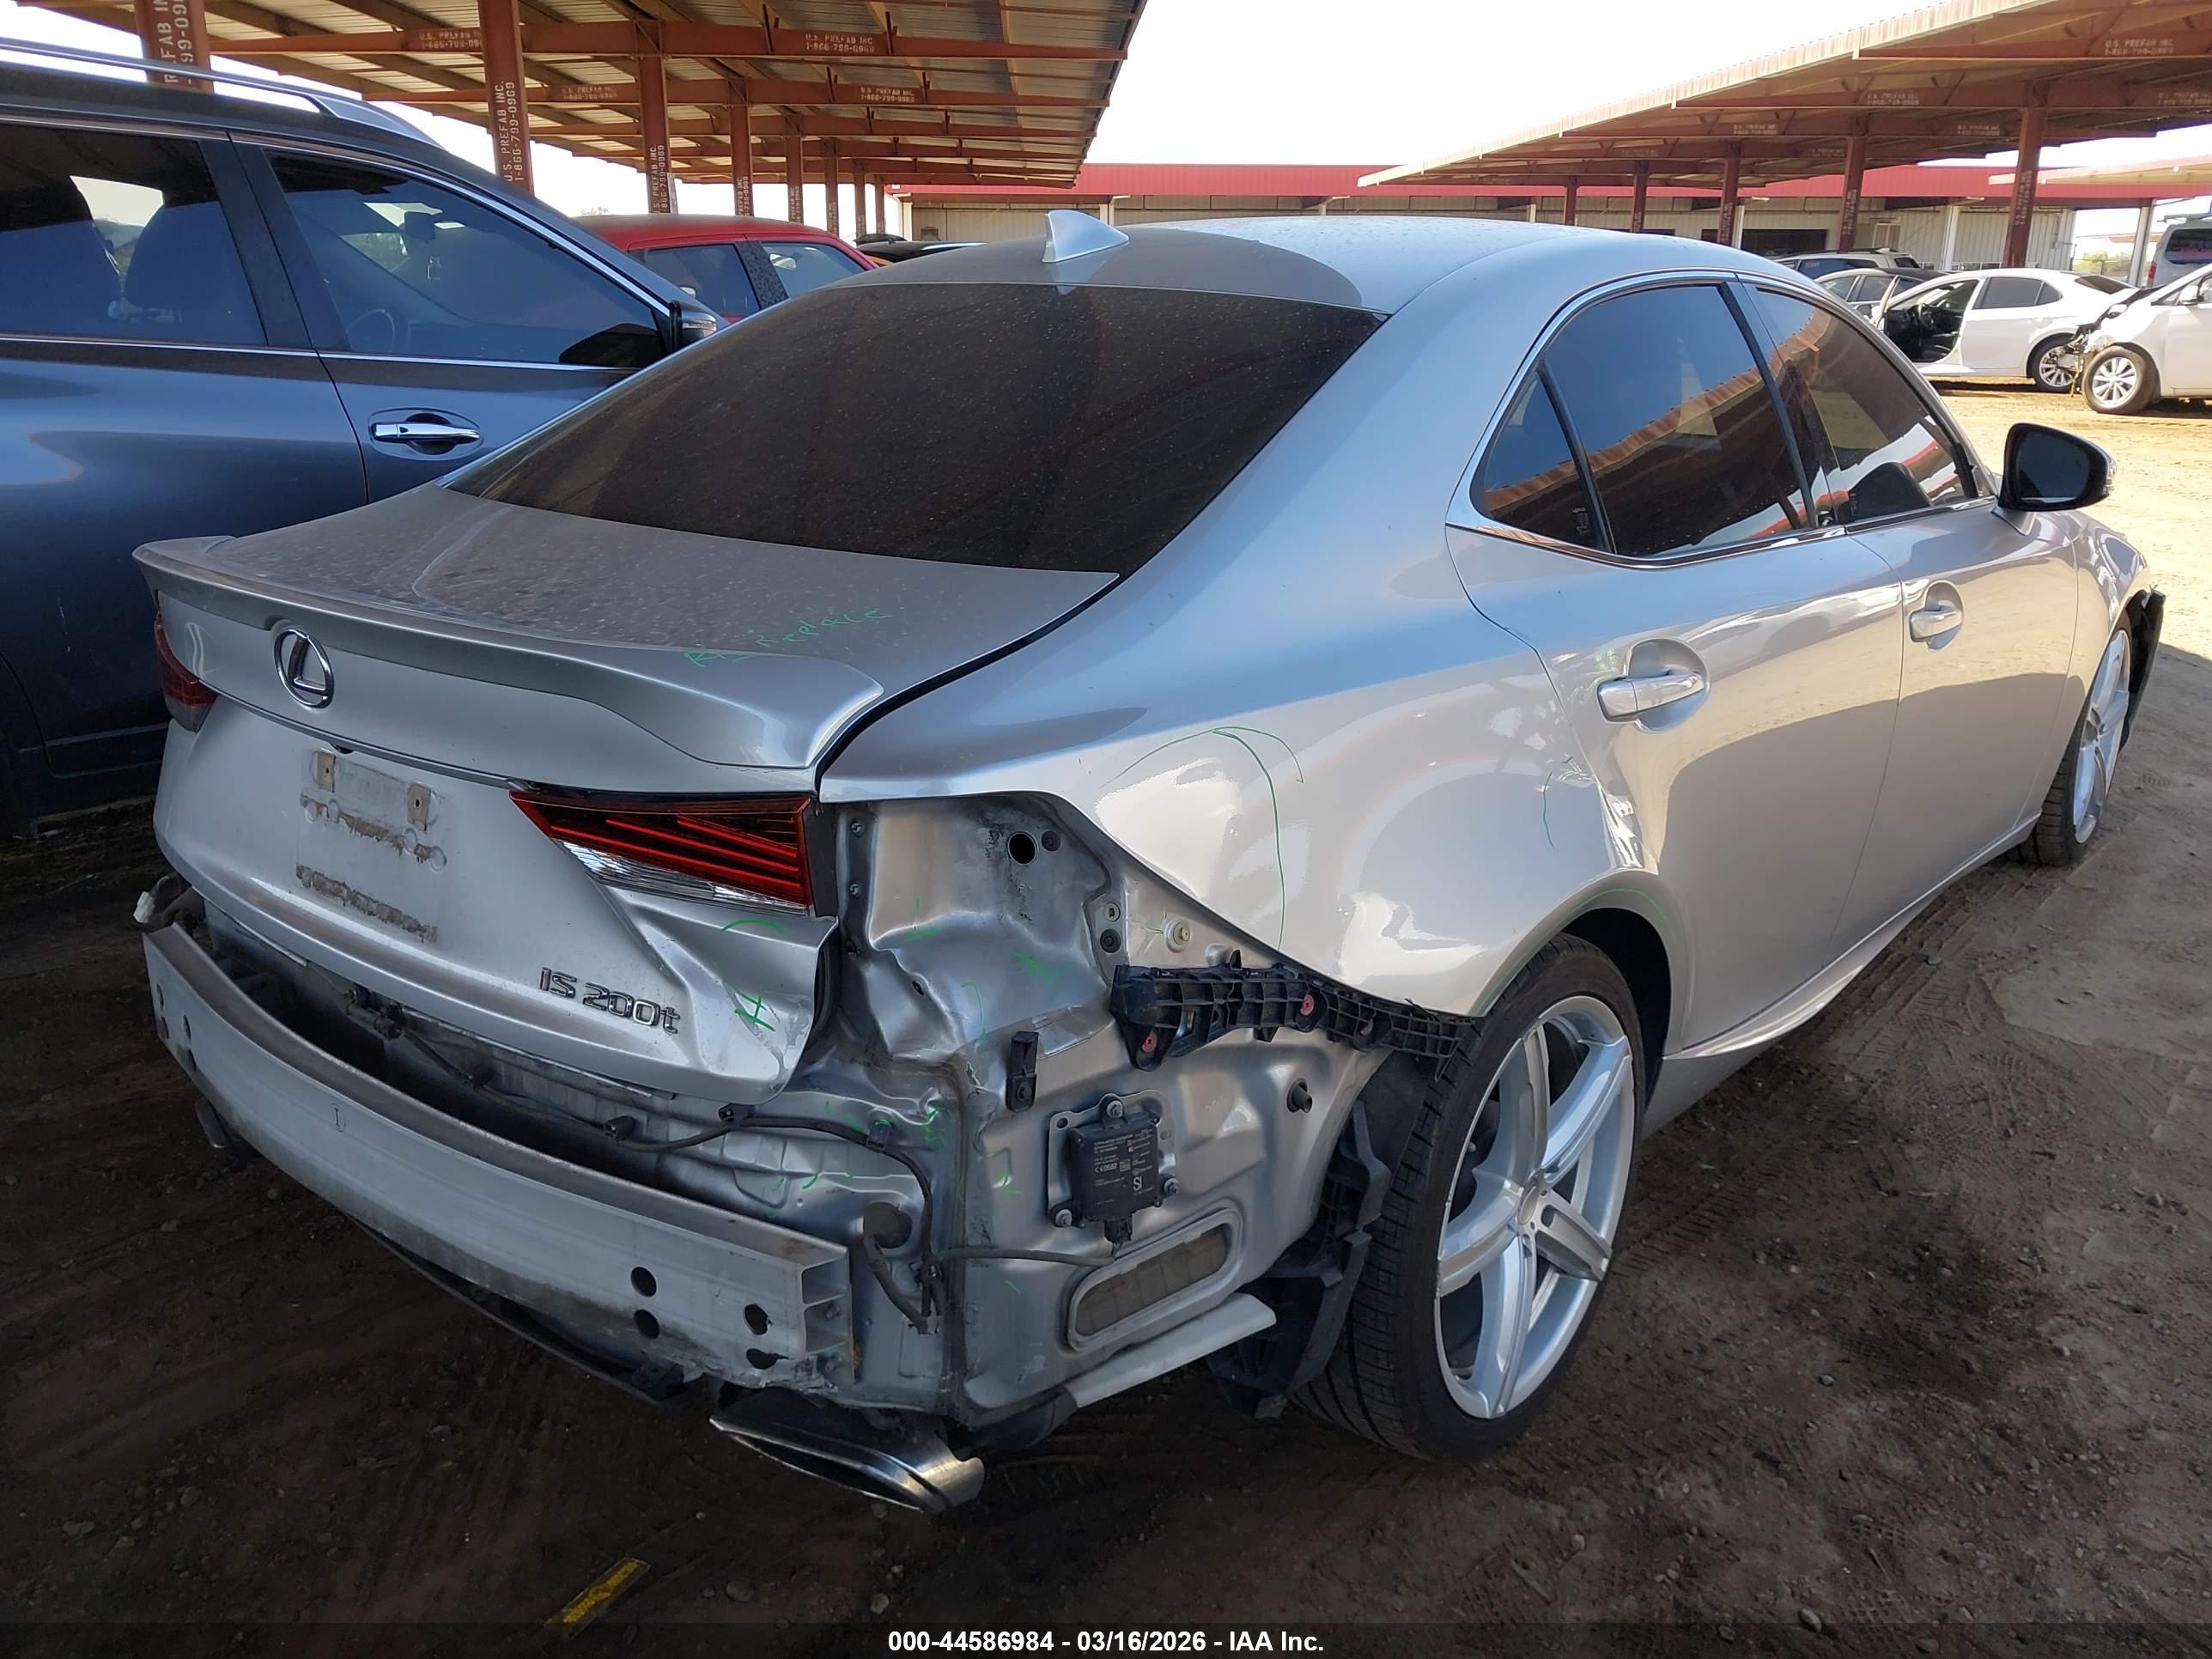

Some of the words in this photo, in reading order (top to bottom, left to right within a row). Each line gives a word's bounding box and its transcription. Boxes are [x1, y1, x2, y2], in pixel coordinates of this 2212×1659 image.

[496, 109, 511, 154] PREFAB
[539, 967, 577, 999] IS
[582, 982, 681, 1034] 200t
